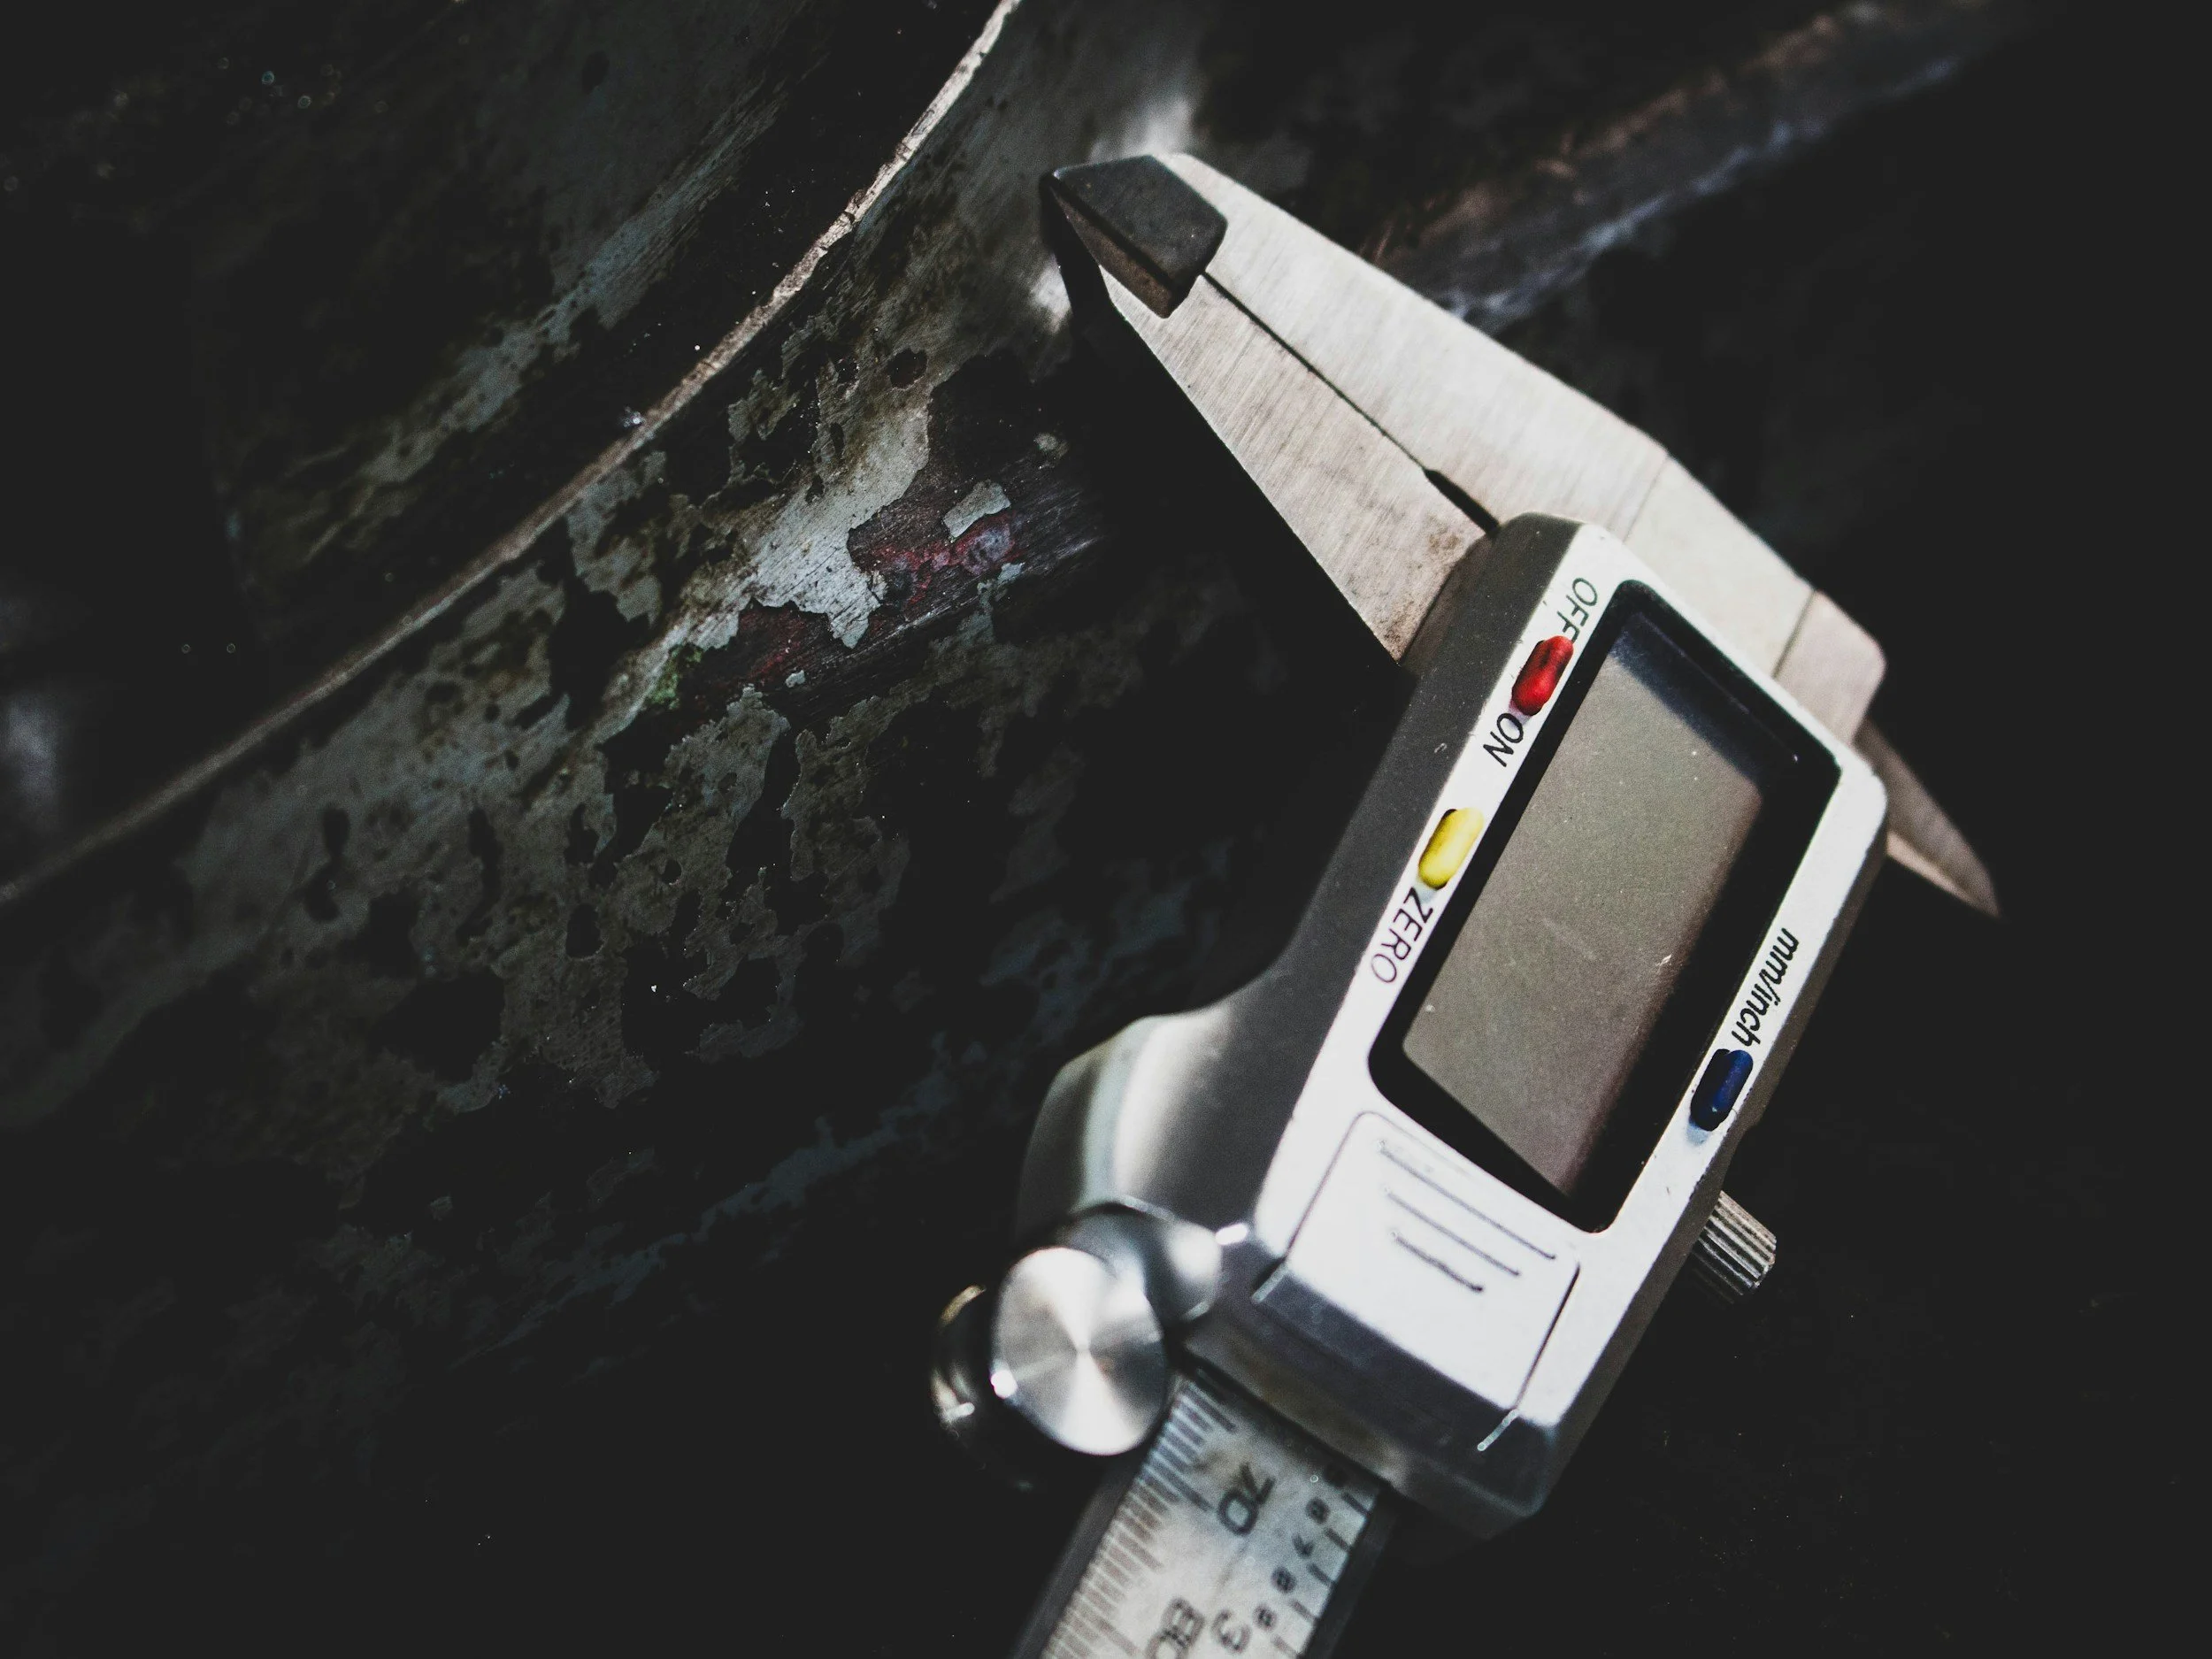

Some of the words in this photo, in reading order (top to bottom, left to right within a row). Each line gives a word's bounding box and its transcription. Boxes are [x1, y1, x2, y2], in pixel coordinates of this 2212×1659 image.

[1556, 577, 1598, 644] OFF
[1482, 712, 1525, 768] ON
[1371, 887, 1433, 983] ZERO
[1731, 927, 1800, 1047] mm/inch
[1216, 1460, 1277, 1536] 70
[1210, 1607, 1253, 1654] 3
